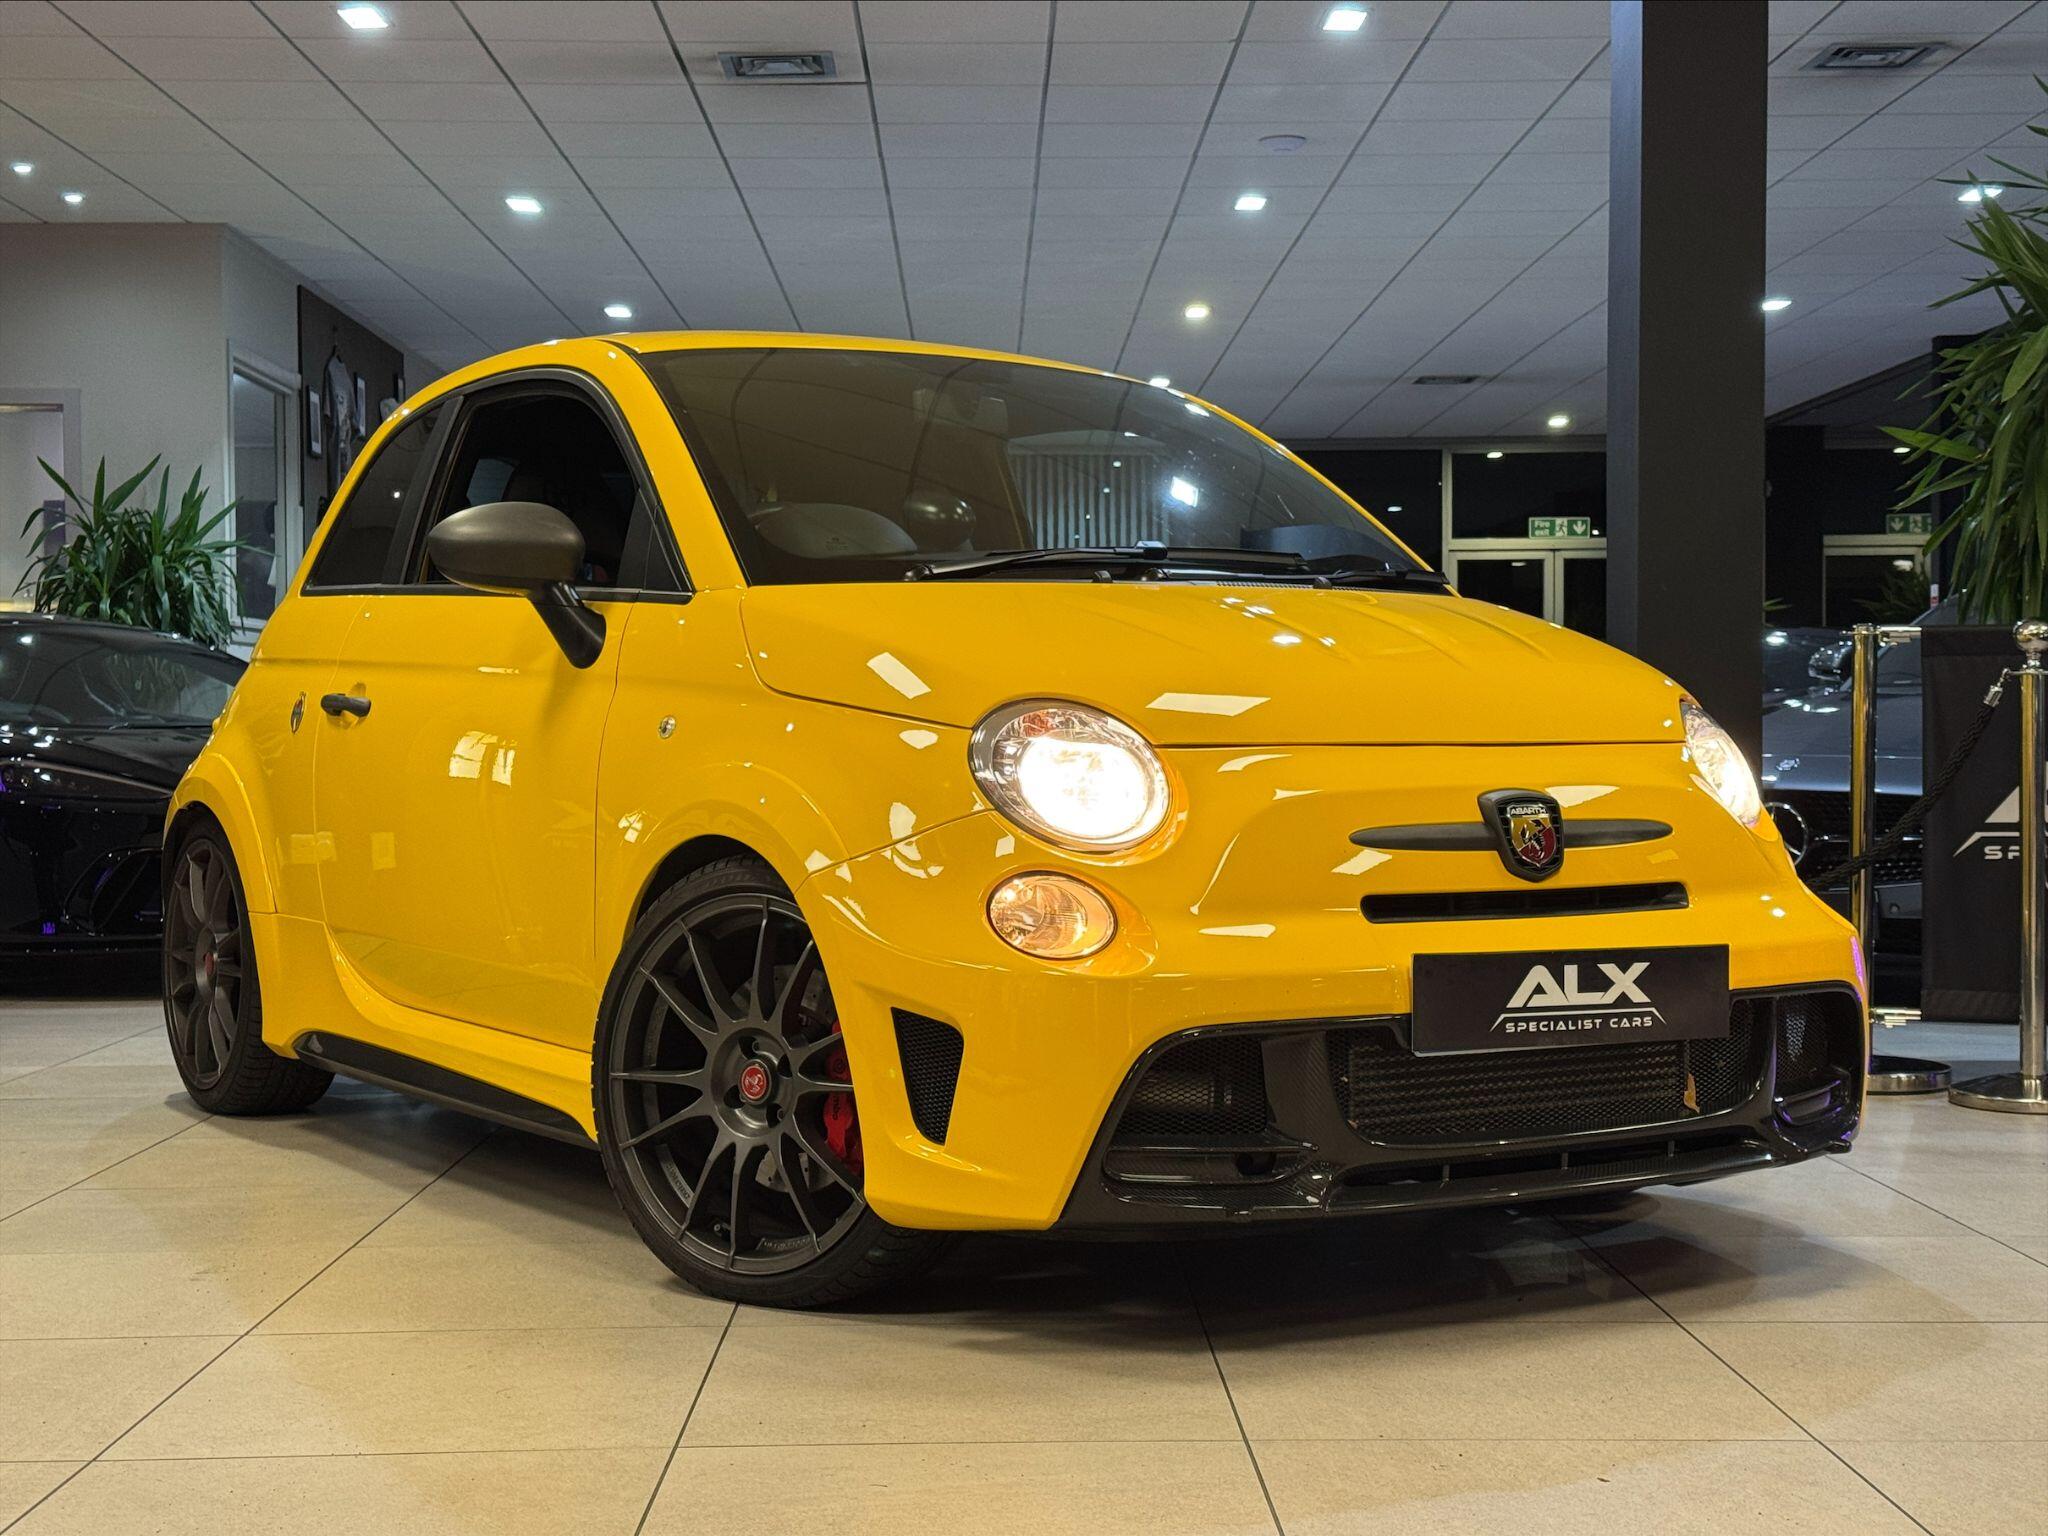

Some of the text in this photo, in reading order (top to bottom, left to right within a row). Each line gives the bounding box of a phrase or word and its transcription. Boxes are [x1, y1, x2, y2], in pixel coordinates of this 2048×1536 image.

[1511, 806, 1547, 815] ABARTH
[1506, 962, 1652, 1008] ALX
[1505, 1016, 1653, 1033] SPECIALIST CARS
